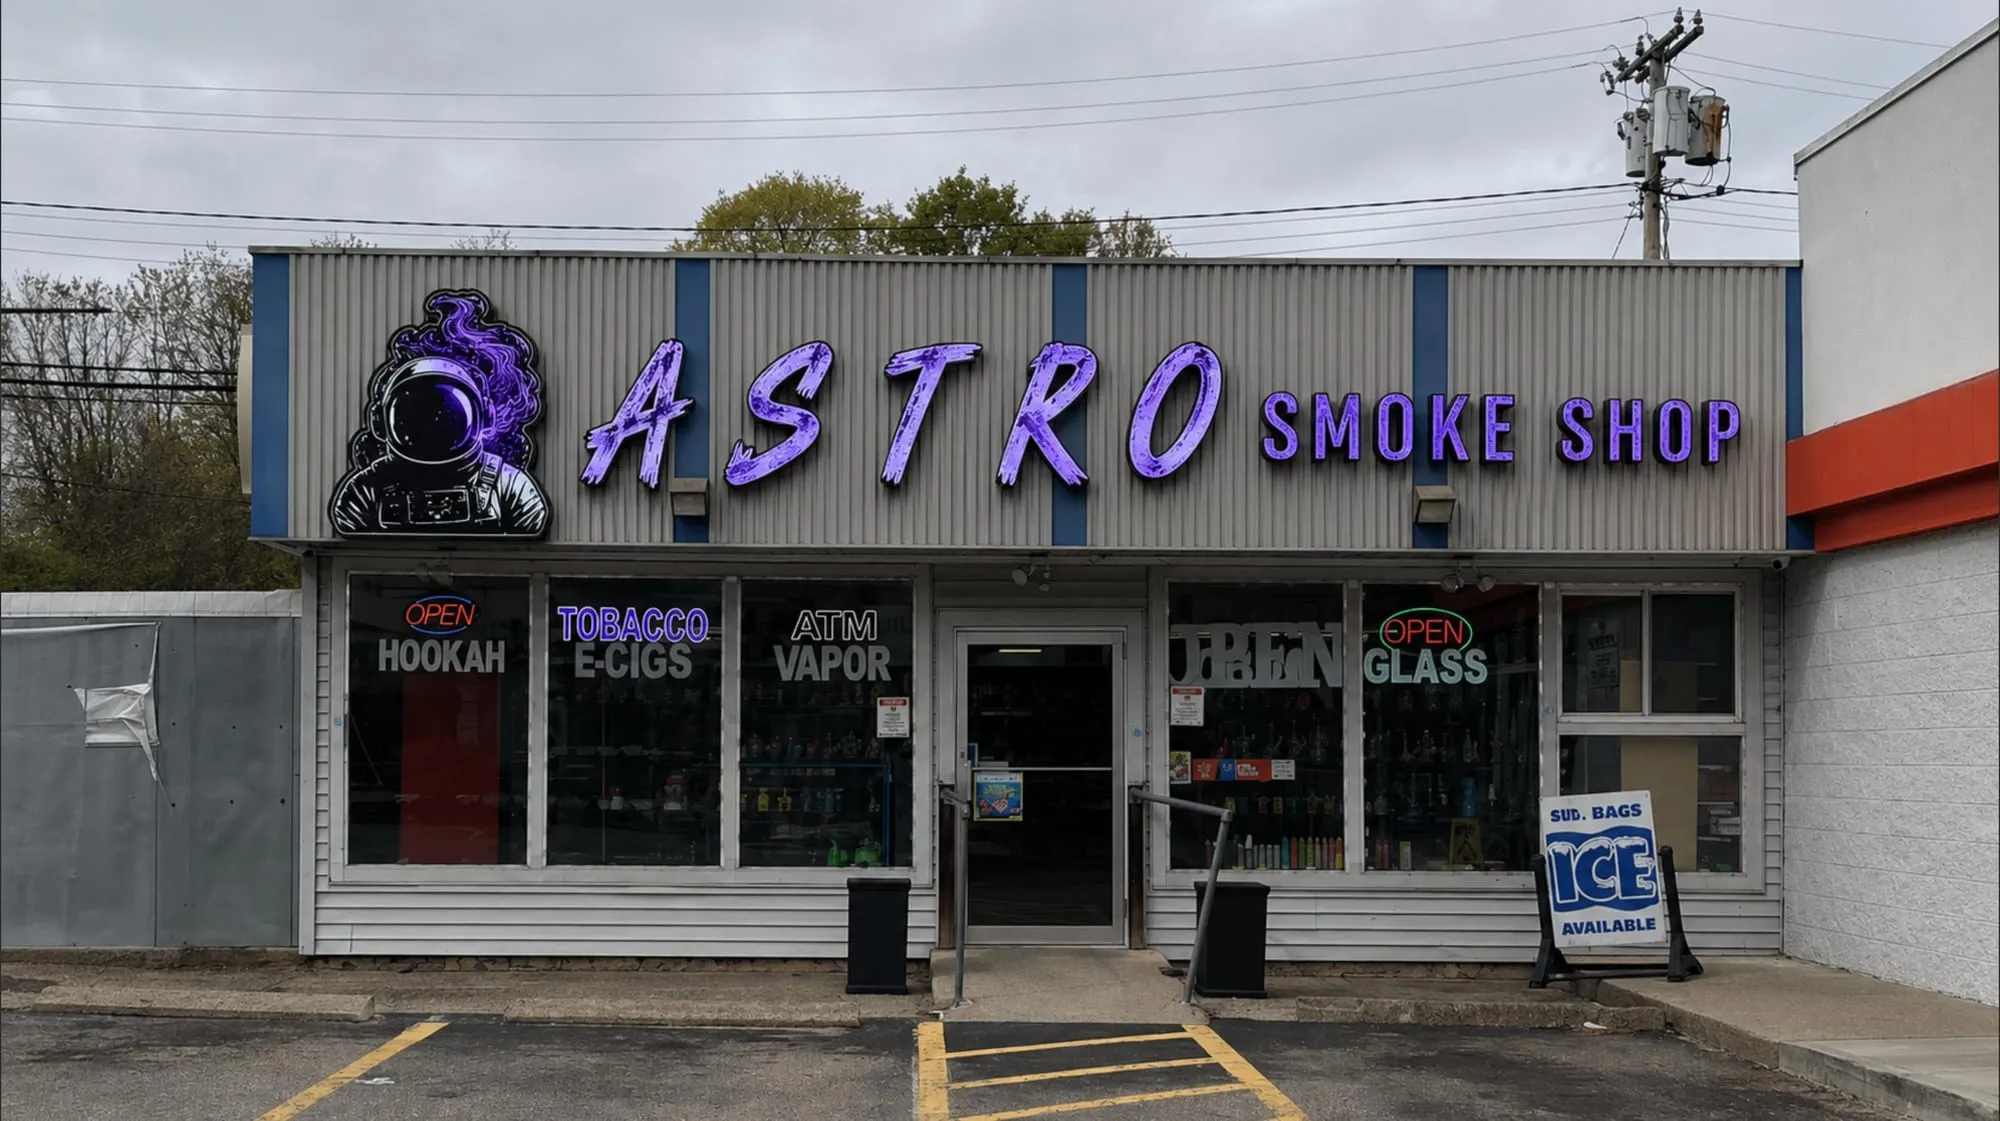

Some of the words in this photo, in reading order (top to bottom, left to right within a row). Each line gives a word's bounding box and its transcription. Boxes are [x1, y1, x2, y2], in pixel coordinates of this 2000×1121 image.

[580, 337, 1223, 489] ASTRO
[1261, 391, 1515, 464] SMOKE
[1558, 397, 1741, 465] SHOP
[405, 602, 476, 626] OPEN
[557, 606, 709, 643] TOBACCO
[791, 610, 878, 641] ATM
[1384, 618, 1464, 645] OPEN
[378, 638, 506, 673] HOOKAH
[574, 642, 693, 679] E-CIGS
[772, 644, 892, 682] VAPOR
[1363, 647, 1488, 685] GLASS
[1592, 803, 1642, 820] BAGS
[1547, 836, 1657, 904] ICE
[1562, 918, 1657, 936] AVAILABLE
